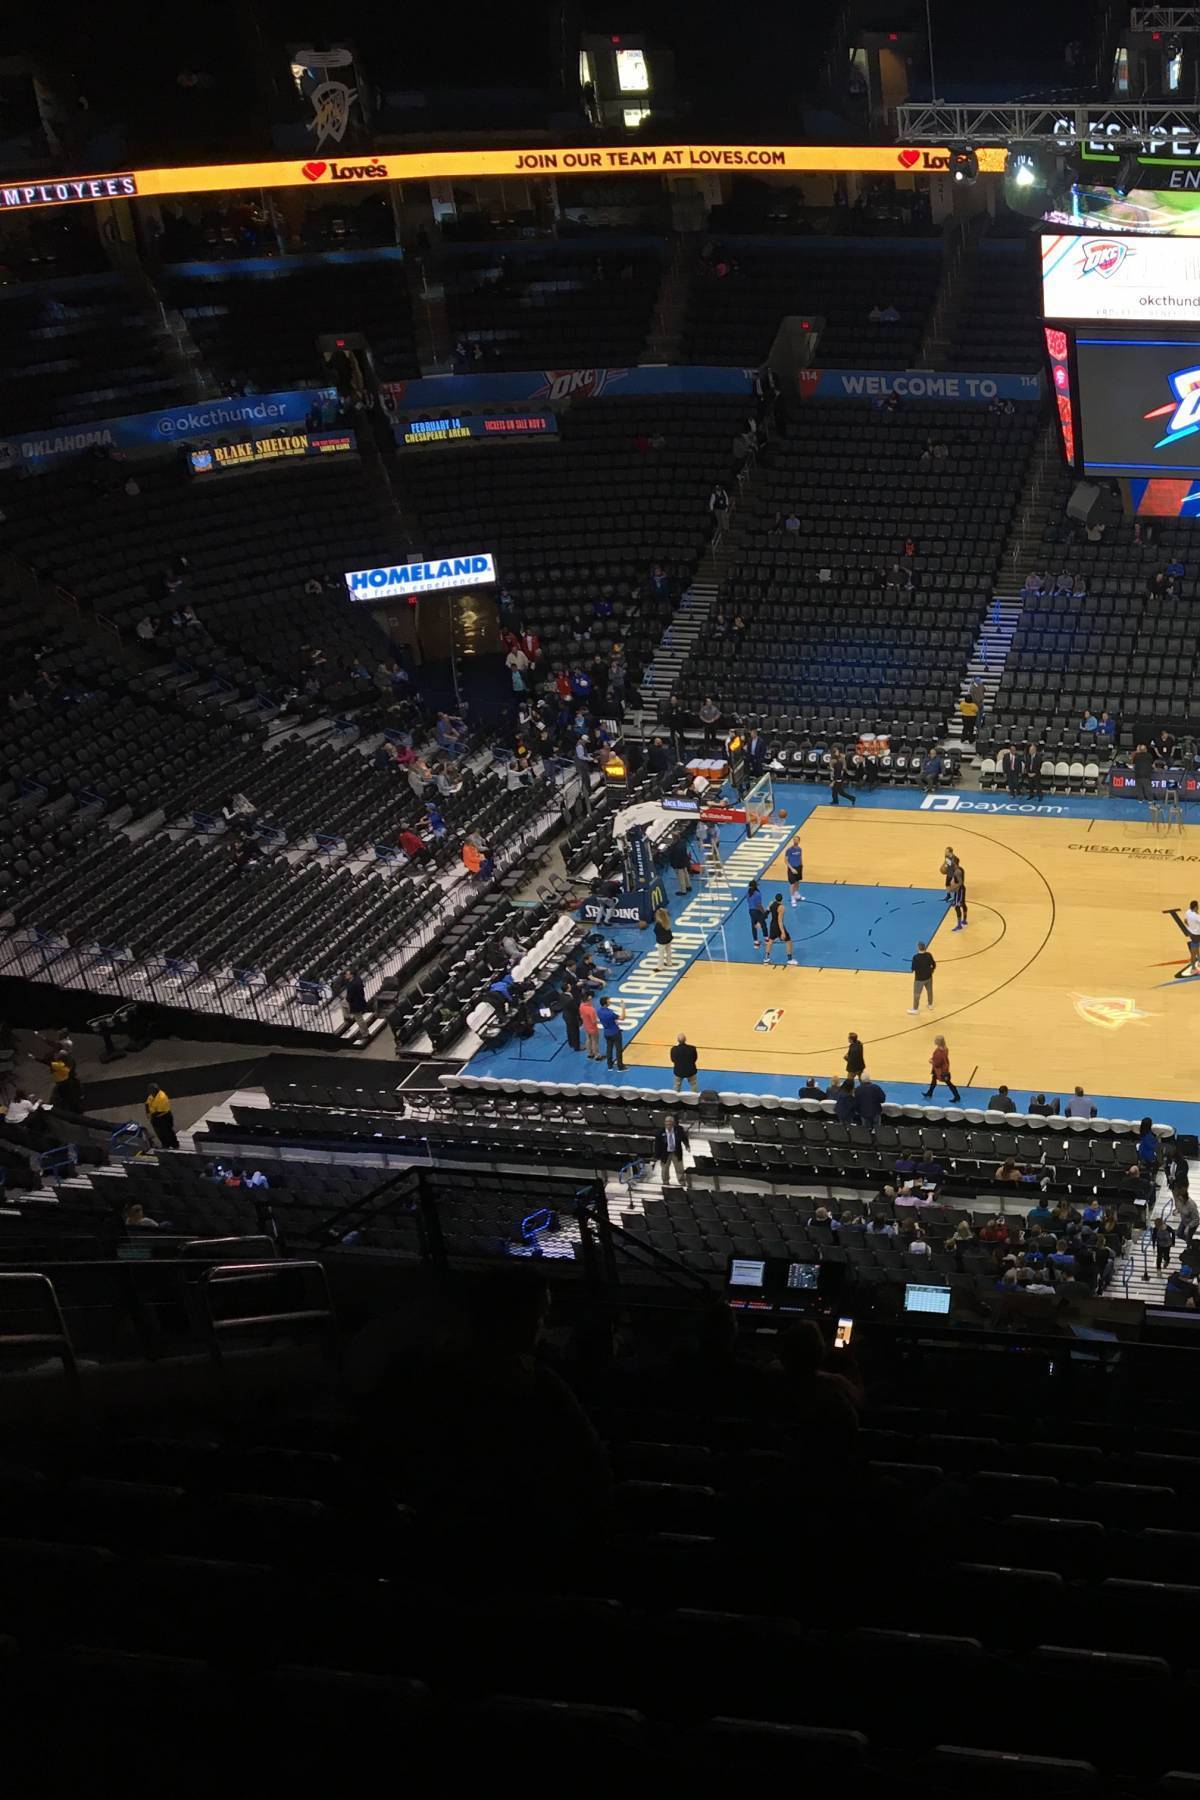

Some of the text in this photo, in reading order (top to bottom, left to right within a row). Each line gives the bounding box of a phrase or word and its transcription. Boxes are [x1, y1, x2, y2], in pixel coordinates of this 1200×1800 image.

[515, 150, 786, 169] JOIN OUR TEAM AT LOVES.COM
[0, 177, 135, 207] MPLOYEES
[551, 369, 594, 398] OKC
[800, 371, 817, 381] 114
[1020, 377, 1038, 387] 114
[841, 376, 998, 398] WELCOME TO
[157, 401, 287, 433] @okcthunder
[411, 418, 460, 433] FEBRUARY 14
[22, 429, 113, 458] OKLAHOMA
[404, 430, 447, 443] CHESAPEAKE
[214, 442, 253, 461] BLAKE
[255, 435, 308, 454] SHELTON
[351, 556, 488, 590] HOMELAND
[413, 576, 480, 592] experience
[794, 751, 802, 761] G
[809, 753, 817, 763] G
[882, 756, 891, 766] G
[897, 757, 905, 767] G
[912, 758, 920, 768] G
[956, 800, 1063, 814] paycom
[1068, 843, 1175, 856] CHESAPEAKE
[585, 905, 640, 921] SPDING
